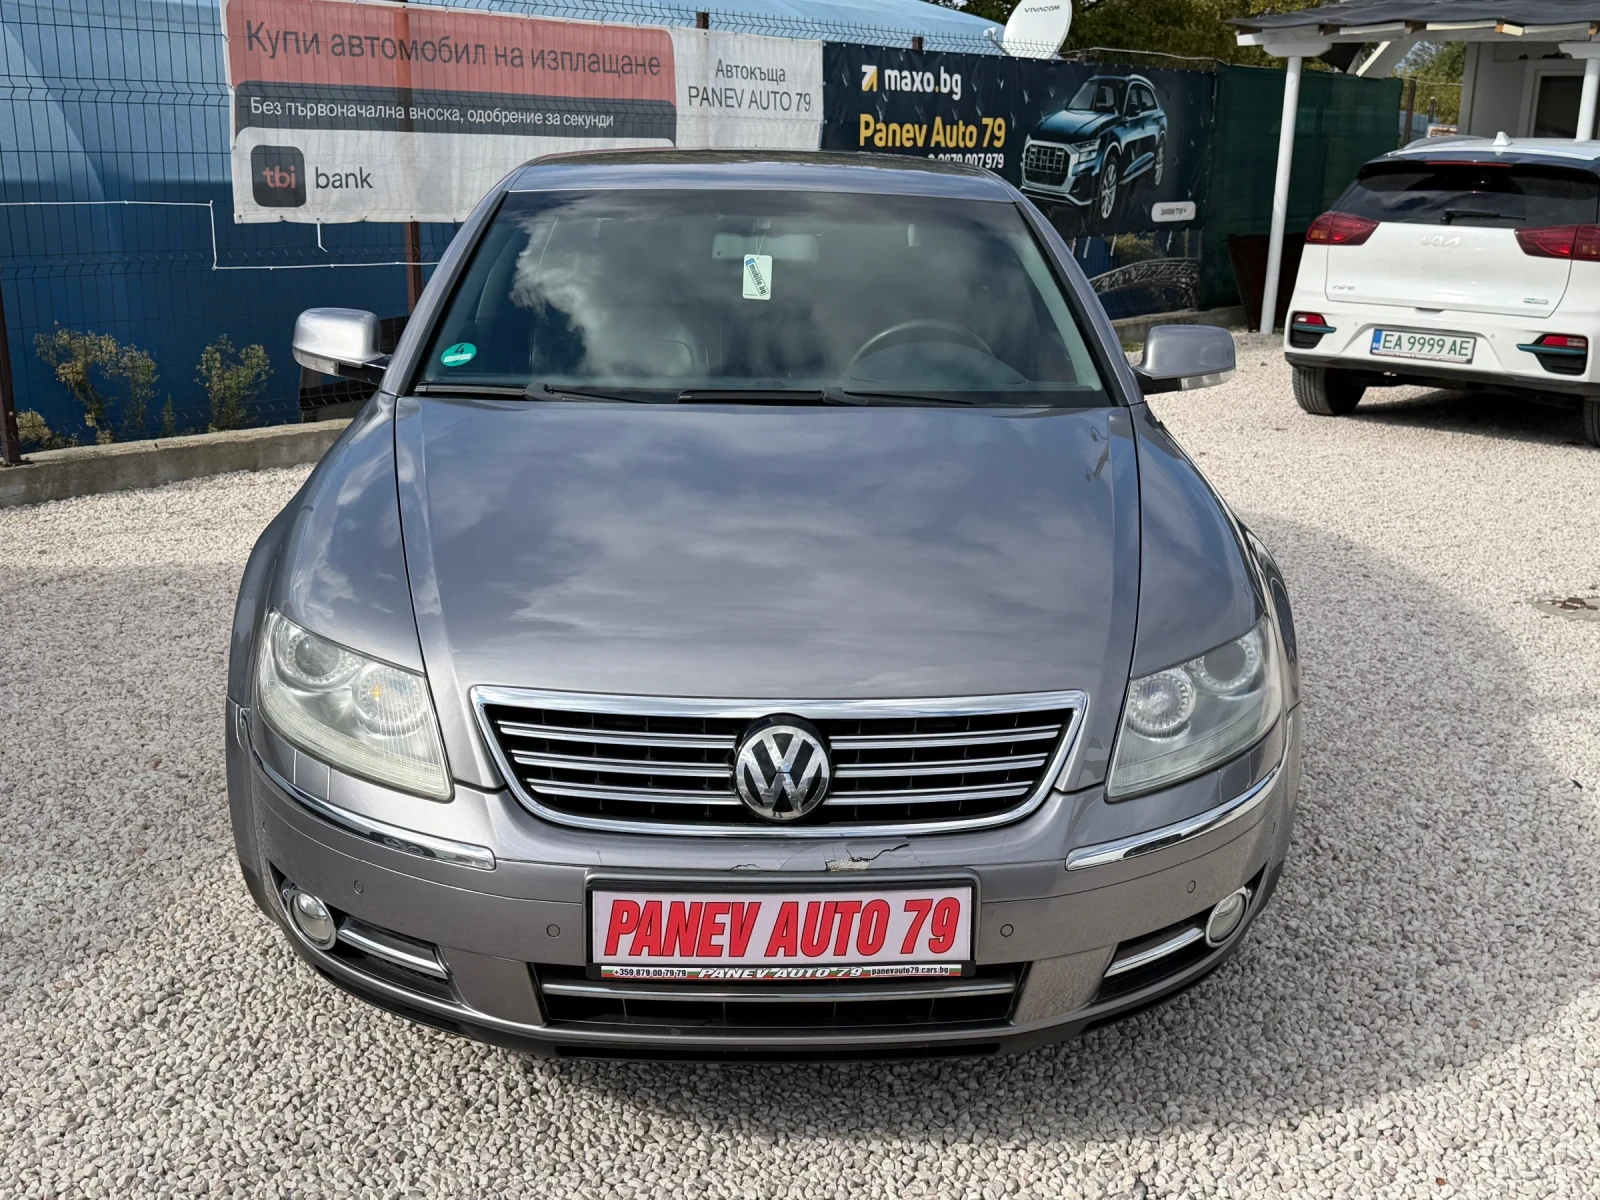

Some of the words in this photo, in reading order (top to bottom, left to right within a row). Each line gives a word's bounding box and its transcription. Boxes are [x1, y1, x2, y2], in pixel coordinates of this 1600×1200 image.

[1024, 4, 1060, 13] VIVACOM
[246, 20, 321, 59] Купи
[330, 33, 486, 65] автомобил
[494, 45, 524, 68] на
[531, 48, 661, 78] изплащане
[715, 59, 786, 84] Автокъща
[884, 66, 961, 100] maxo.bg
[688, 86, 744, 109] PANEV
[748, 91, 792, 112] AUTO
[795, 92, 811, 112] 79
[250, 97, 282, 115] Без
[285, 102, 405, 119] първоначална
[409, 107, 464, 123] вноска,
[467, 108, 543, 125] одобрение
[545, 115, 560, 125] за
[562, 115, 614, 128] секунди
[859, 113, 927, 148] Panev
[930, 116, 977, 148] Auto
[981, 117, 1006, 148] 79
[985, 153, 1005, 168] 979
[262, 165, 296, 189] tbi
[315, 167, 374, 189] bank
[455, 343, 465, 355] 4
[1382, 333, 1403, 351] EA
[1407, 336, 1445, 354] 9999
[1447, 339, 1471, 357] AE
[604, 899, 762, 958] PANEV
[764, 899, 891, 957] AUTO
[900, 897, 961, 954] 79
[613, 968, 634, 976] +359
[636, 968, 650, 977] 879
[698, 968, 769, 979] PANEV
[771, 968, 831, 979] AUTO
[836, 967, 864, 978] 79
